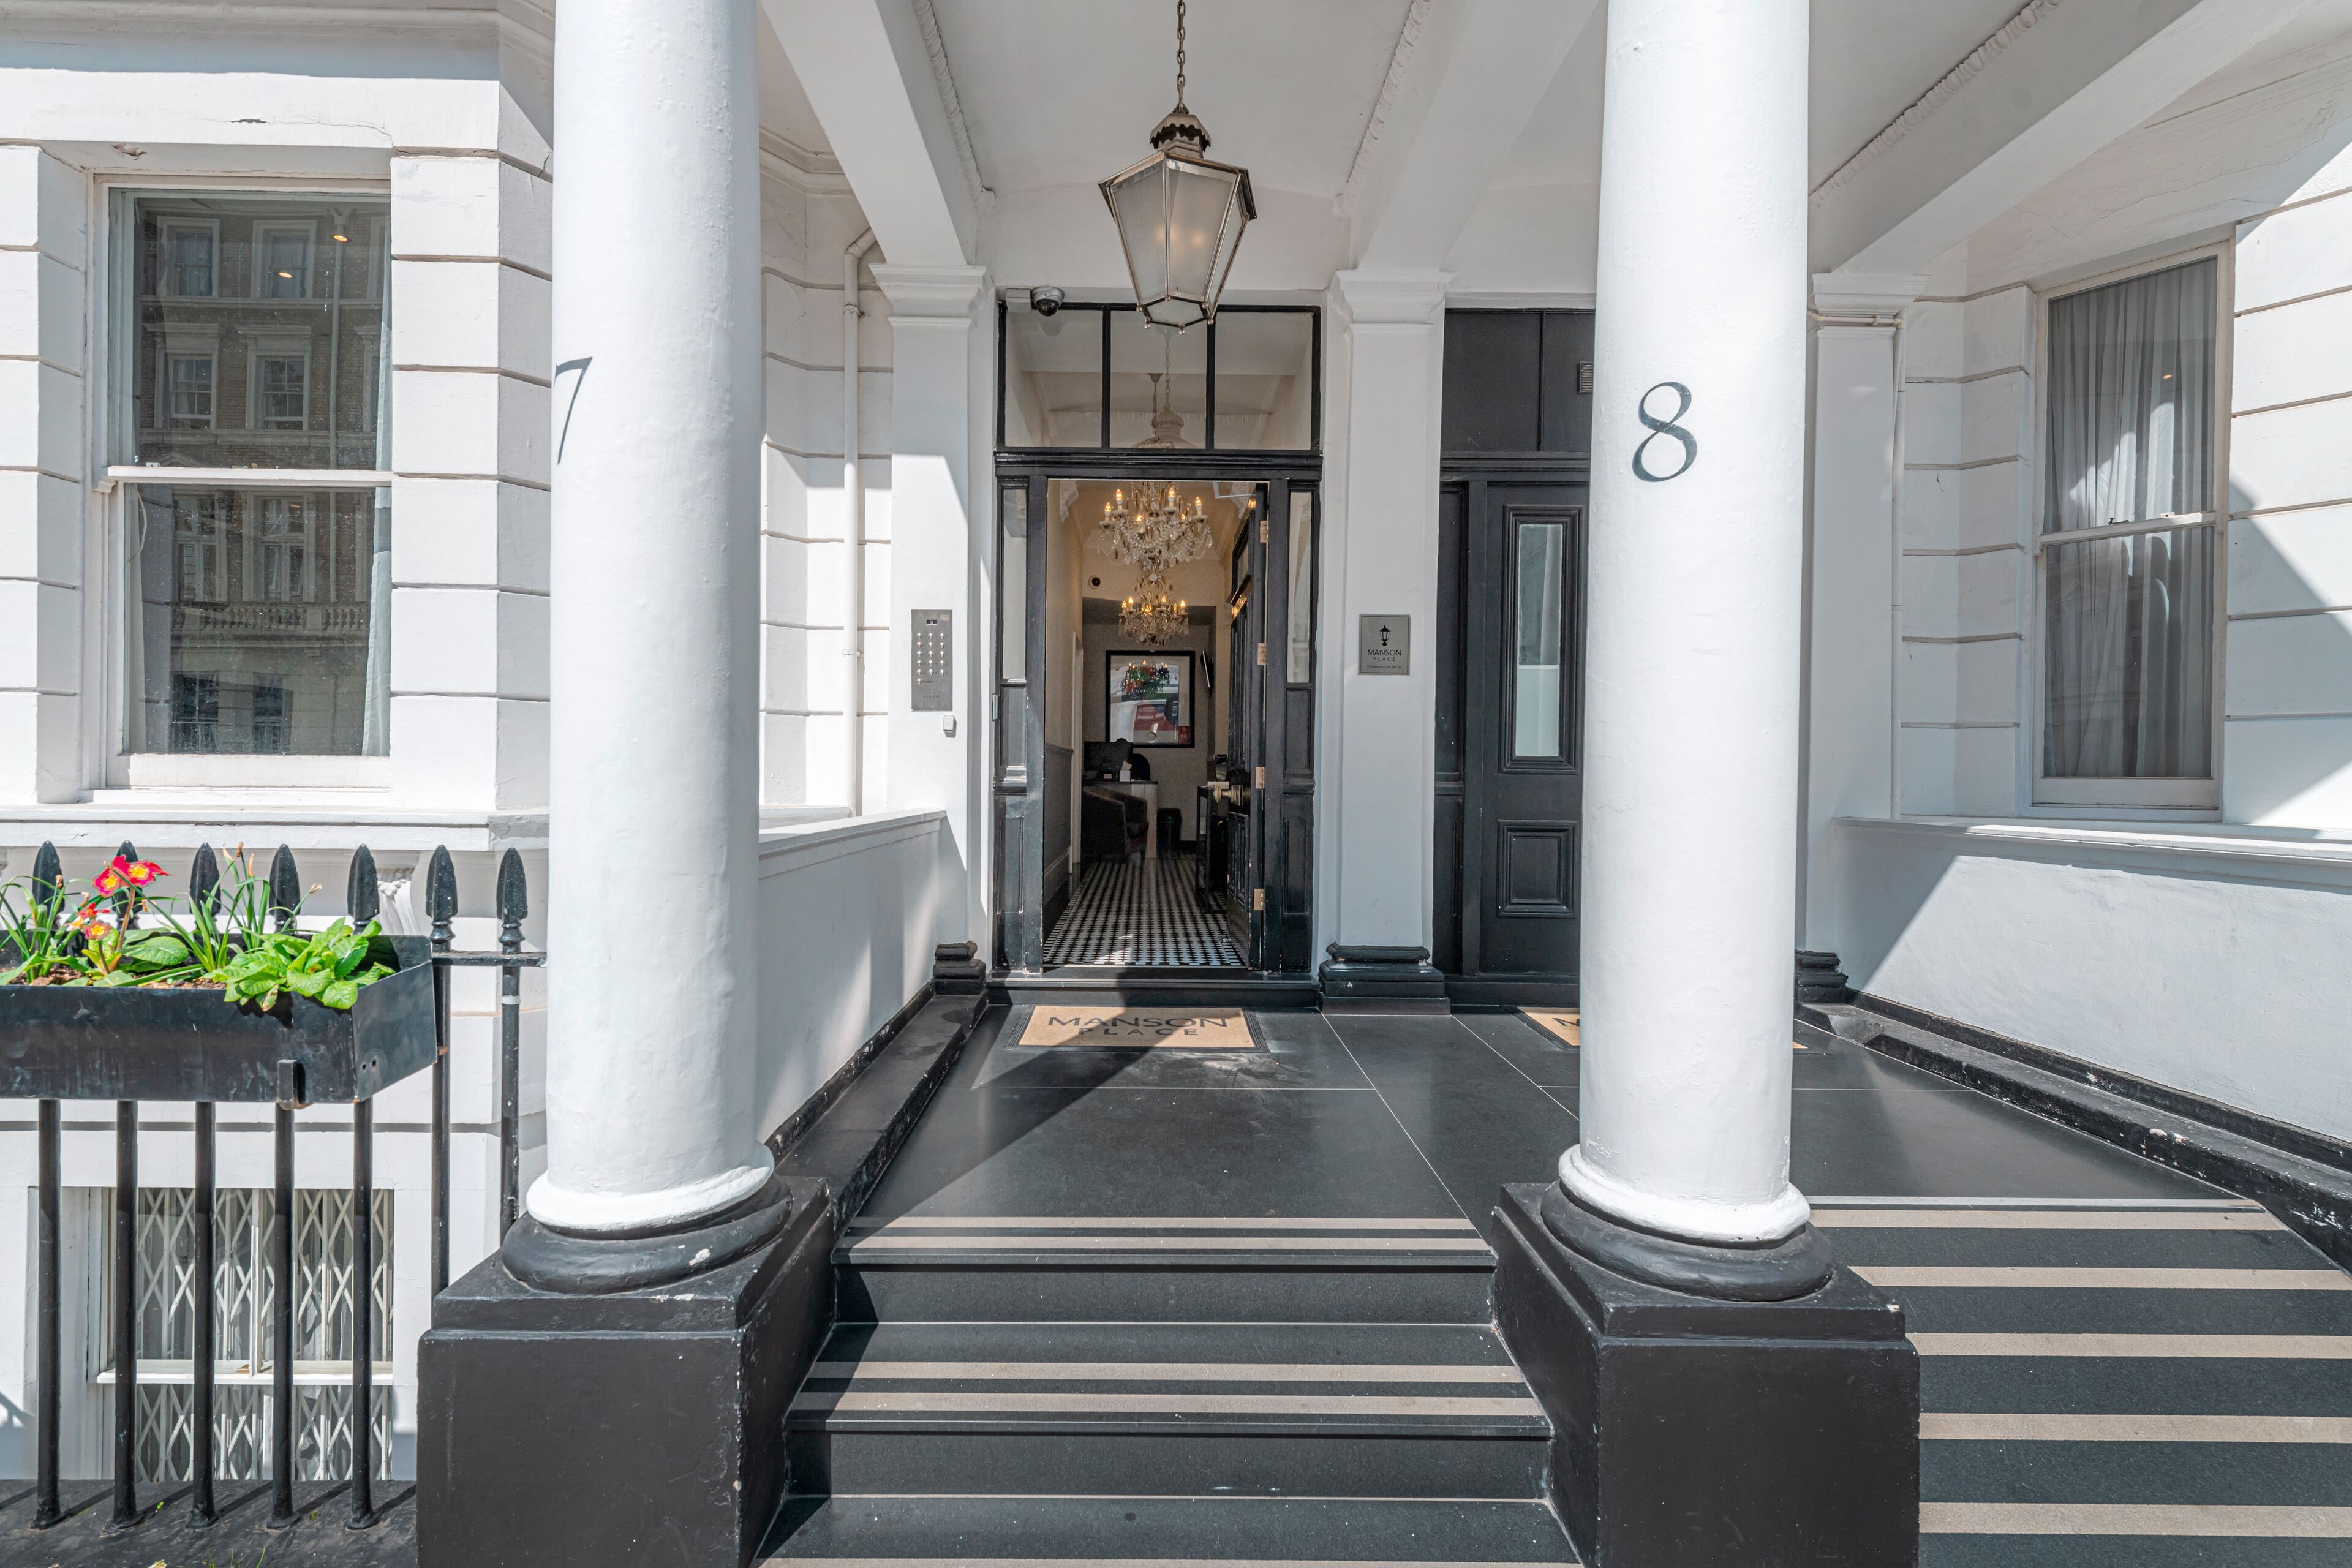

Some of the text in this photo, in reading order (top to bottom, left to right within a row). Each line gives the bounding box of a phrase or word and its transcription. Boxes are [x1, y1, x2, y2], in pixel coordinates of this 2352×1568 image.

[553, 356, 593, 466] 7
[1632, 382, 1697, 482] 8
[1048, 1017, 1227, 1027] MANSON
